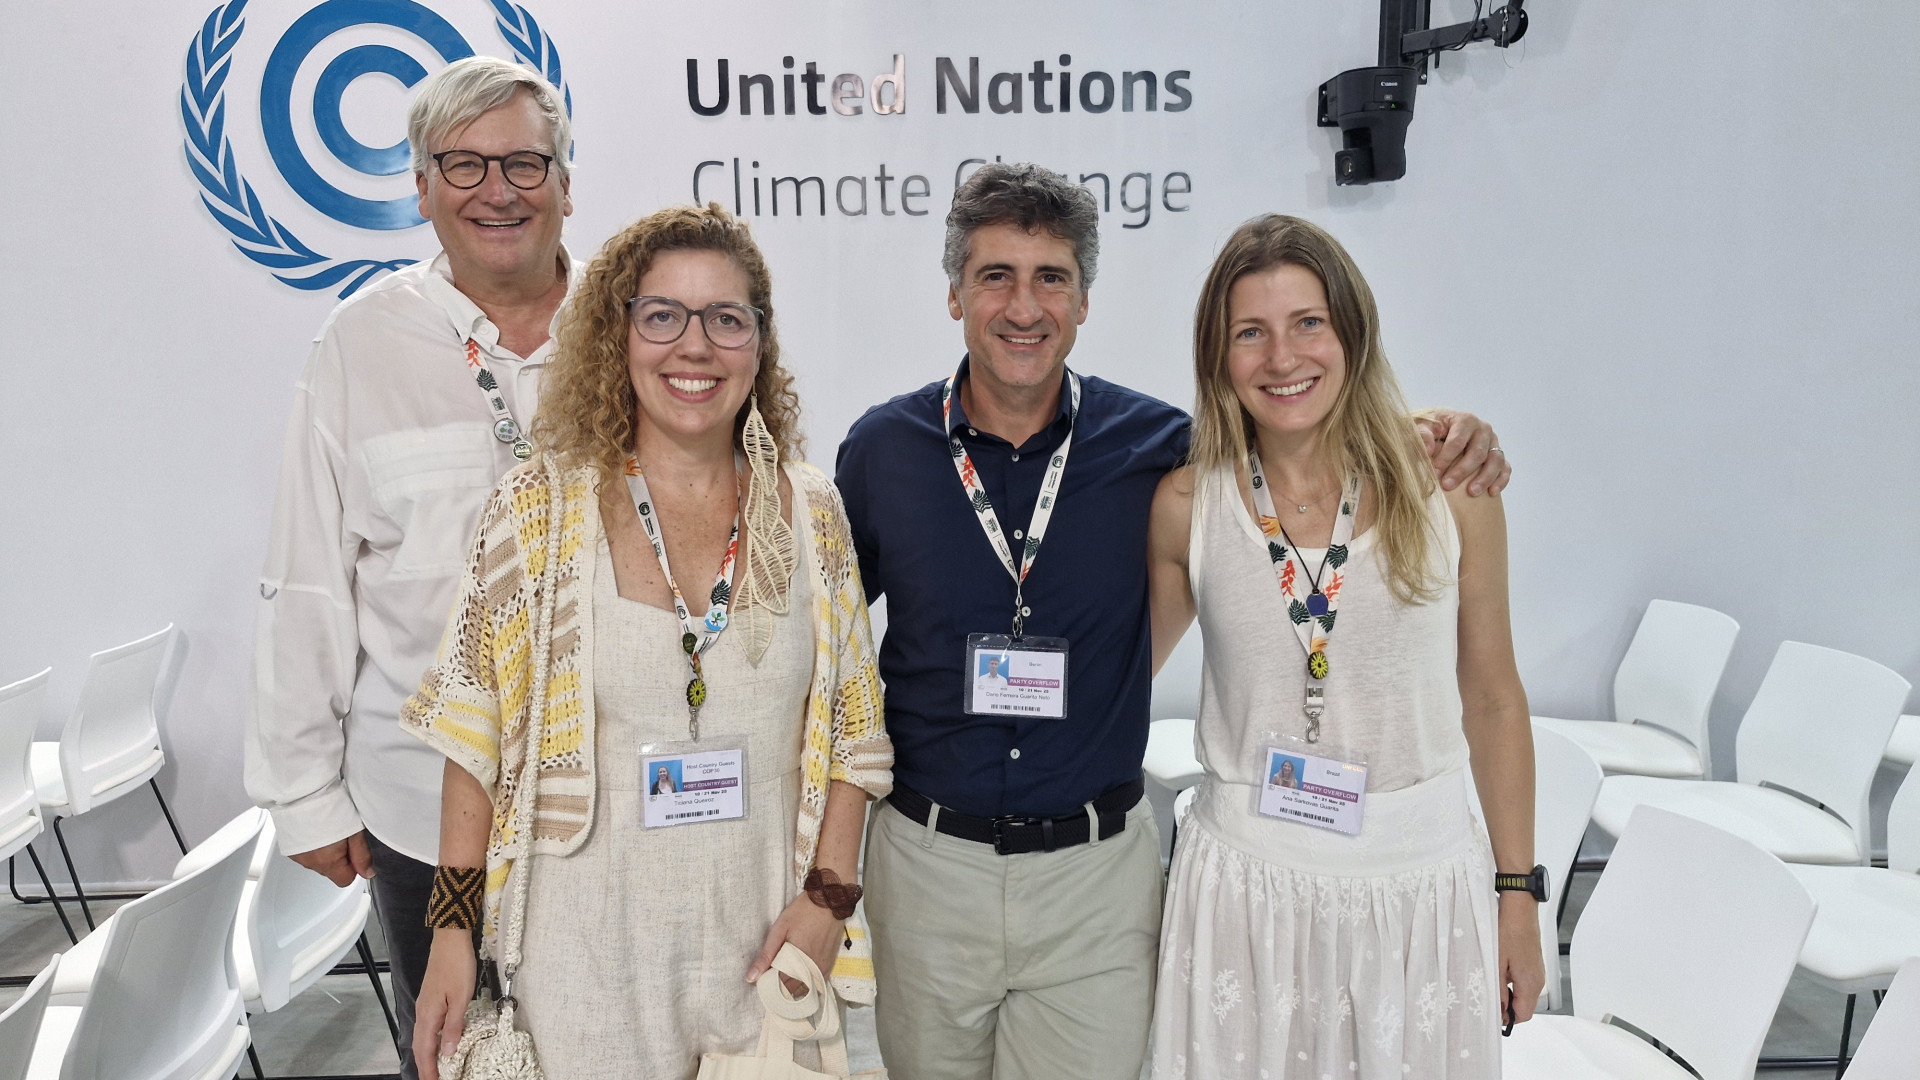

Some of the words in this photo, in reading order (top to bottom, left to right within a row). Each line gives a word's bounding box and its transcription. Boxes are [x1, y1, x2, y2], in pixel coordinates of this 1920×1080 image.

[686, 54, 906, 116] United
[935, 53, 1193, 114] Nations
[692, 157, 931, 217] Climate
[1302, 784, 1322, 793] PARTY
[1323, 788, 1357, 800] OVERFLOW
